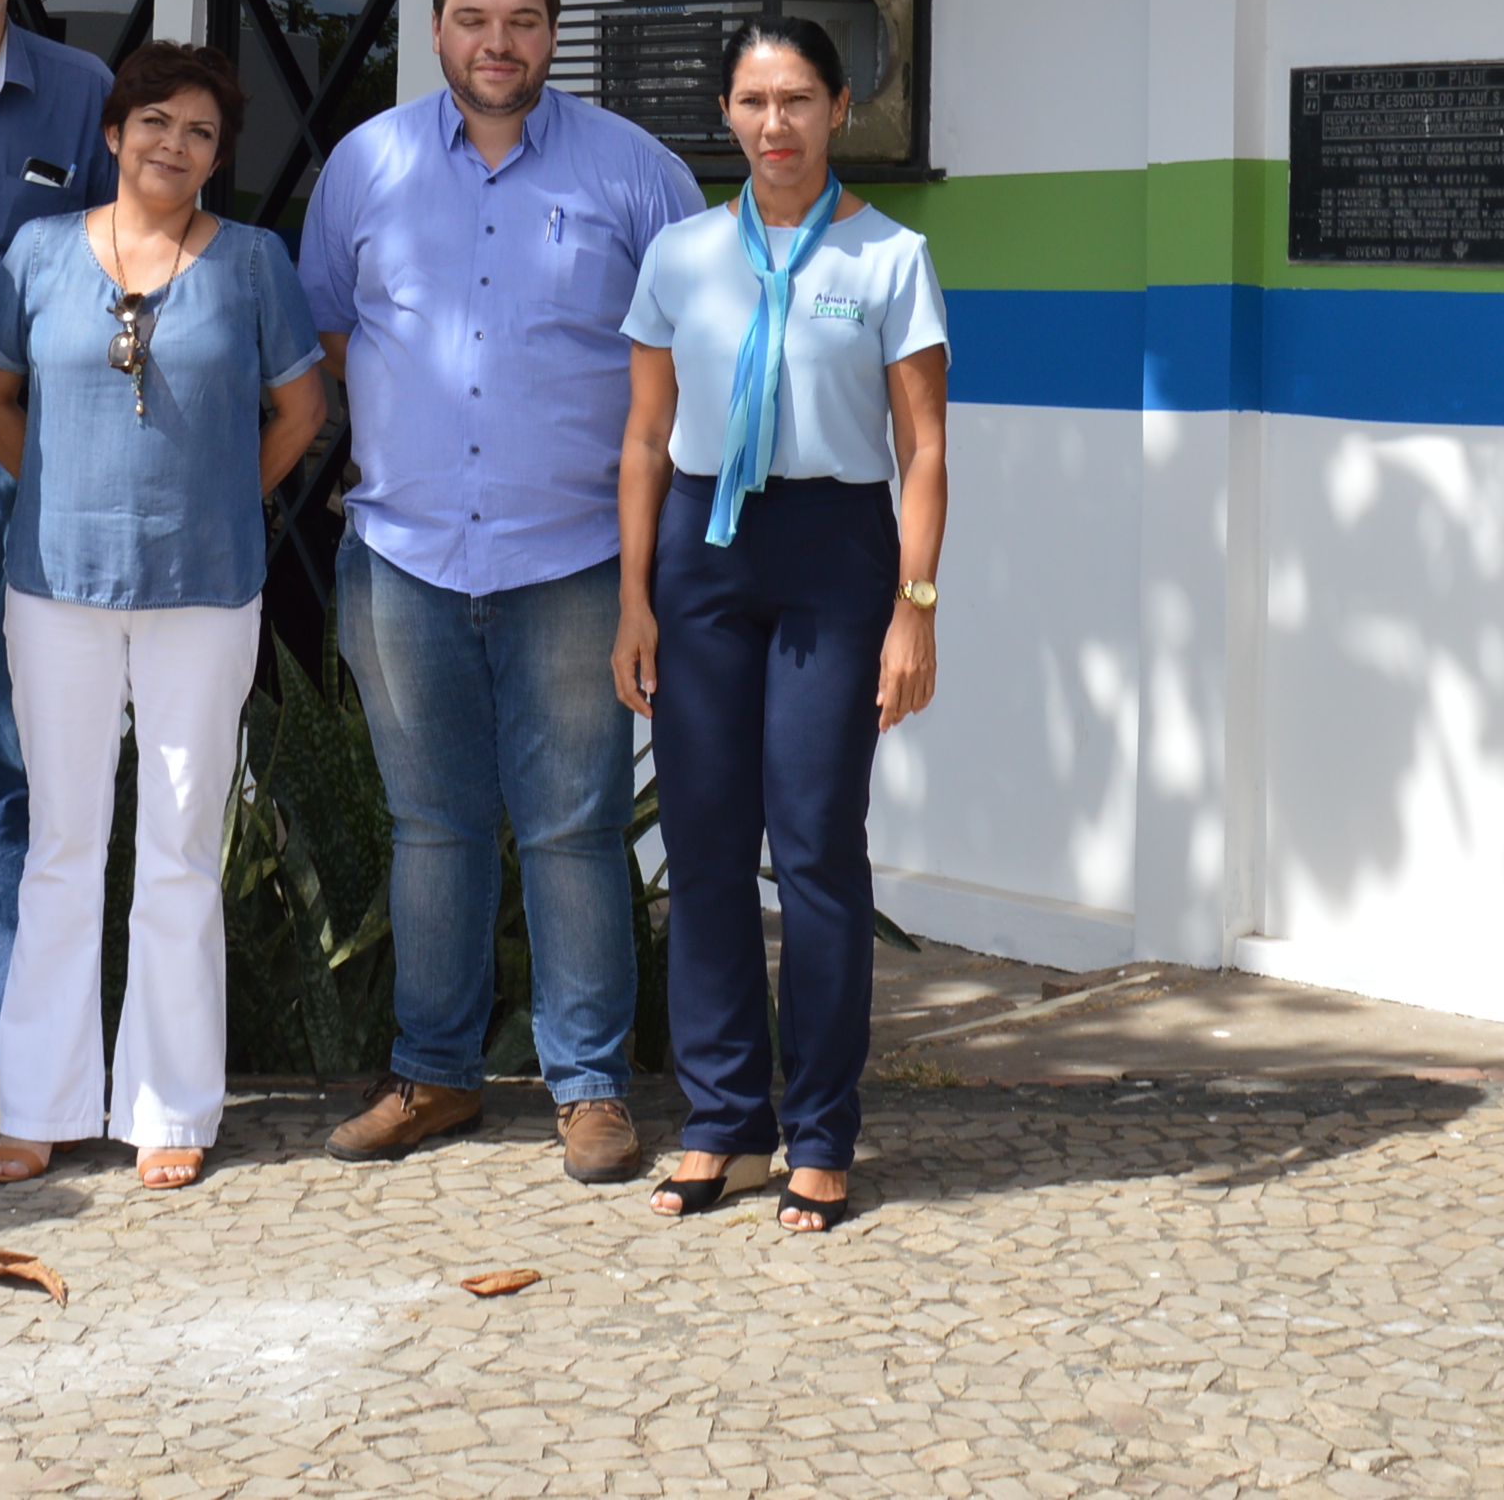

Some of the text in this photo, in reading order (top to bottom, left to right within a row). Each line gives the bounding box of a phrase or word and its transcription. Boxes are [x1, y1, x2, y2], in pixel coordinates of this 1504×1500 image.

[1351, 73, 1404, 89] ESTADO
[1417, 72, 1435, 88] DO
[1386, 92, 1435, 108] ESGOTOS
[1439, 92, 1453, 106] DO
[1346, 246, 1390, 258] GOVERNO
[1396, 246, 1409, 258] DO
[813, 302, 865, 321] Teresina
